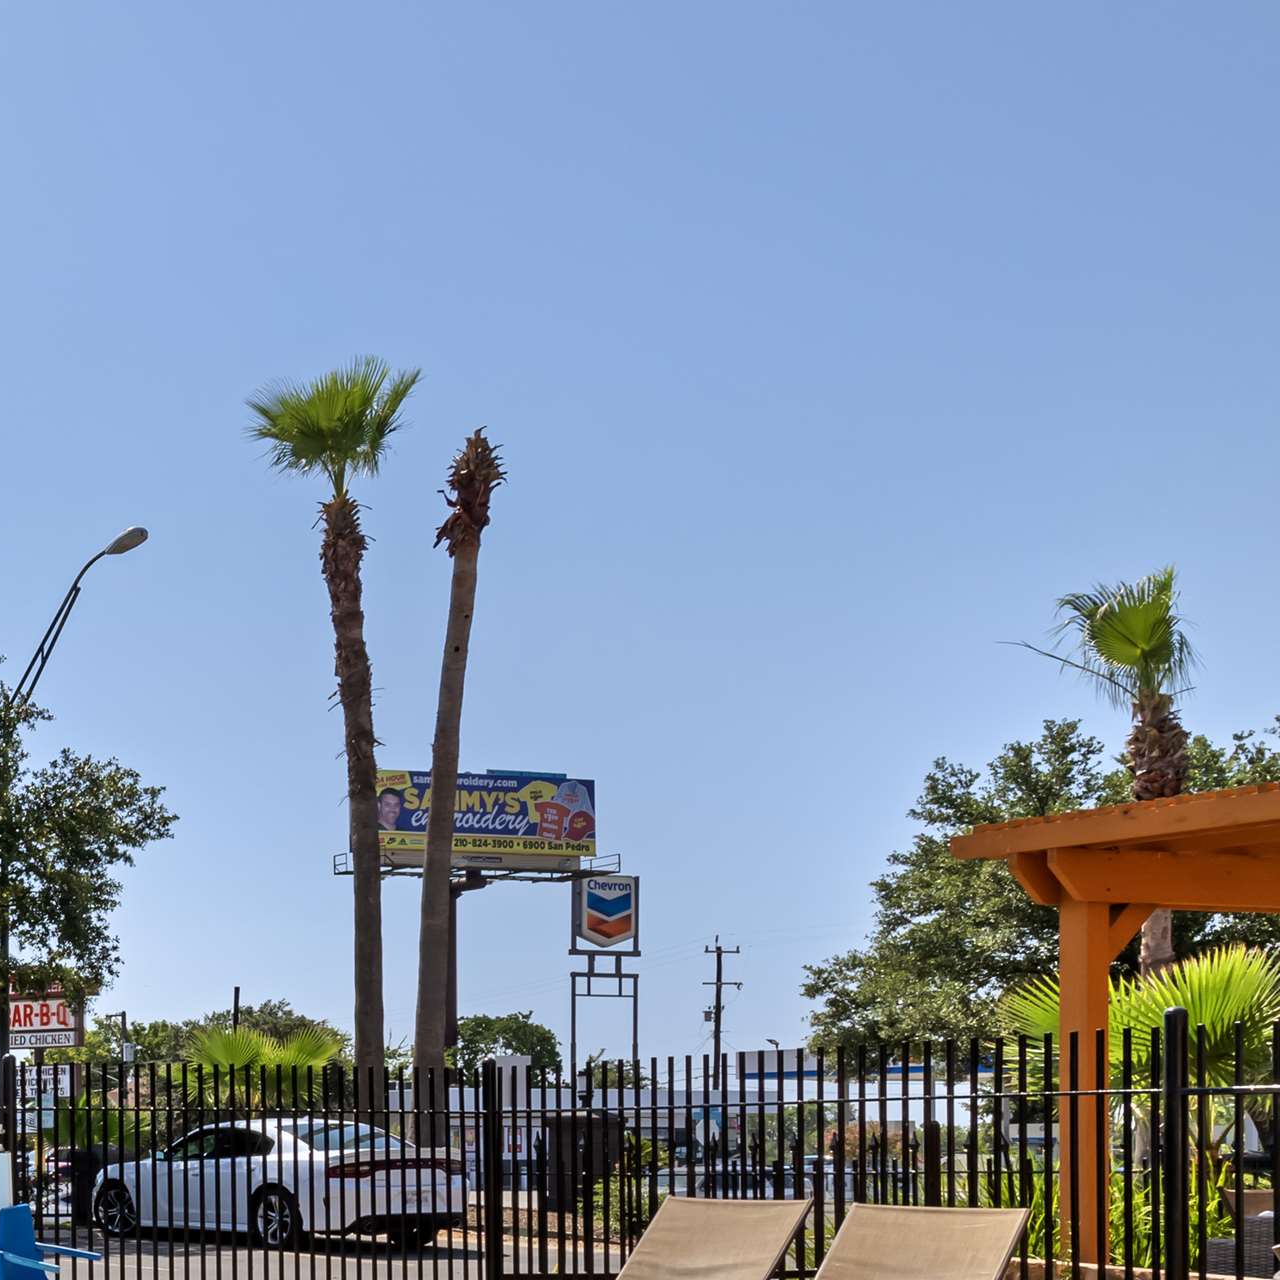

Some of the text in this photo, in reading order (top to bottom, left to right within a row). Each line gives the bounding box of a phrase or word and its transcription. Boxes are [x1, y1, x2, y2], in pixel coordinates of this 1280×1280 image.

[413, 775, 518, 788] samroidery.com
[403, 787, 521, 814] SAMY'S
[411, 804, 530, 836] eroidery
[547, 842, 564, 851] San
[565, 842, 591, 853] Pedro
[587, 878, 632, 892] Chevron
[9, 1002, 69, 1028] AR-B-Q
[28, 1033, 72, 1046] CHICKEN
